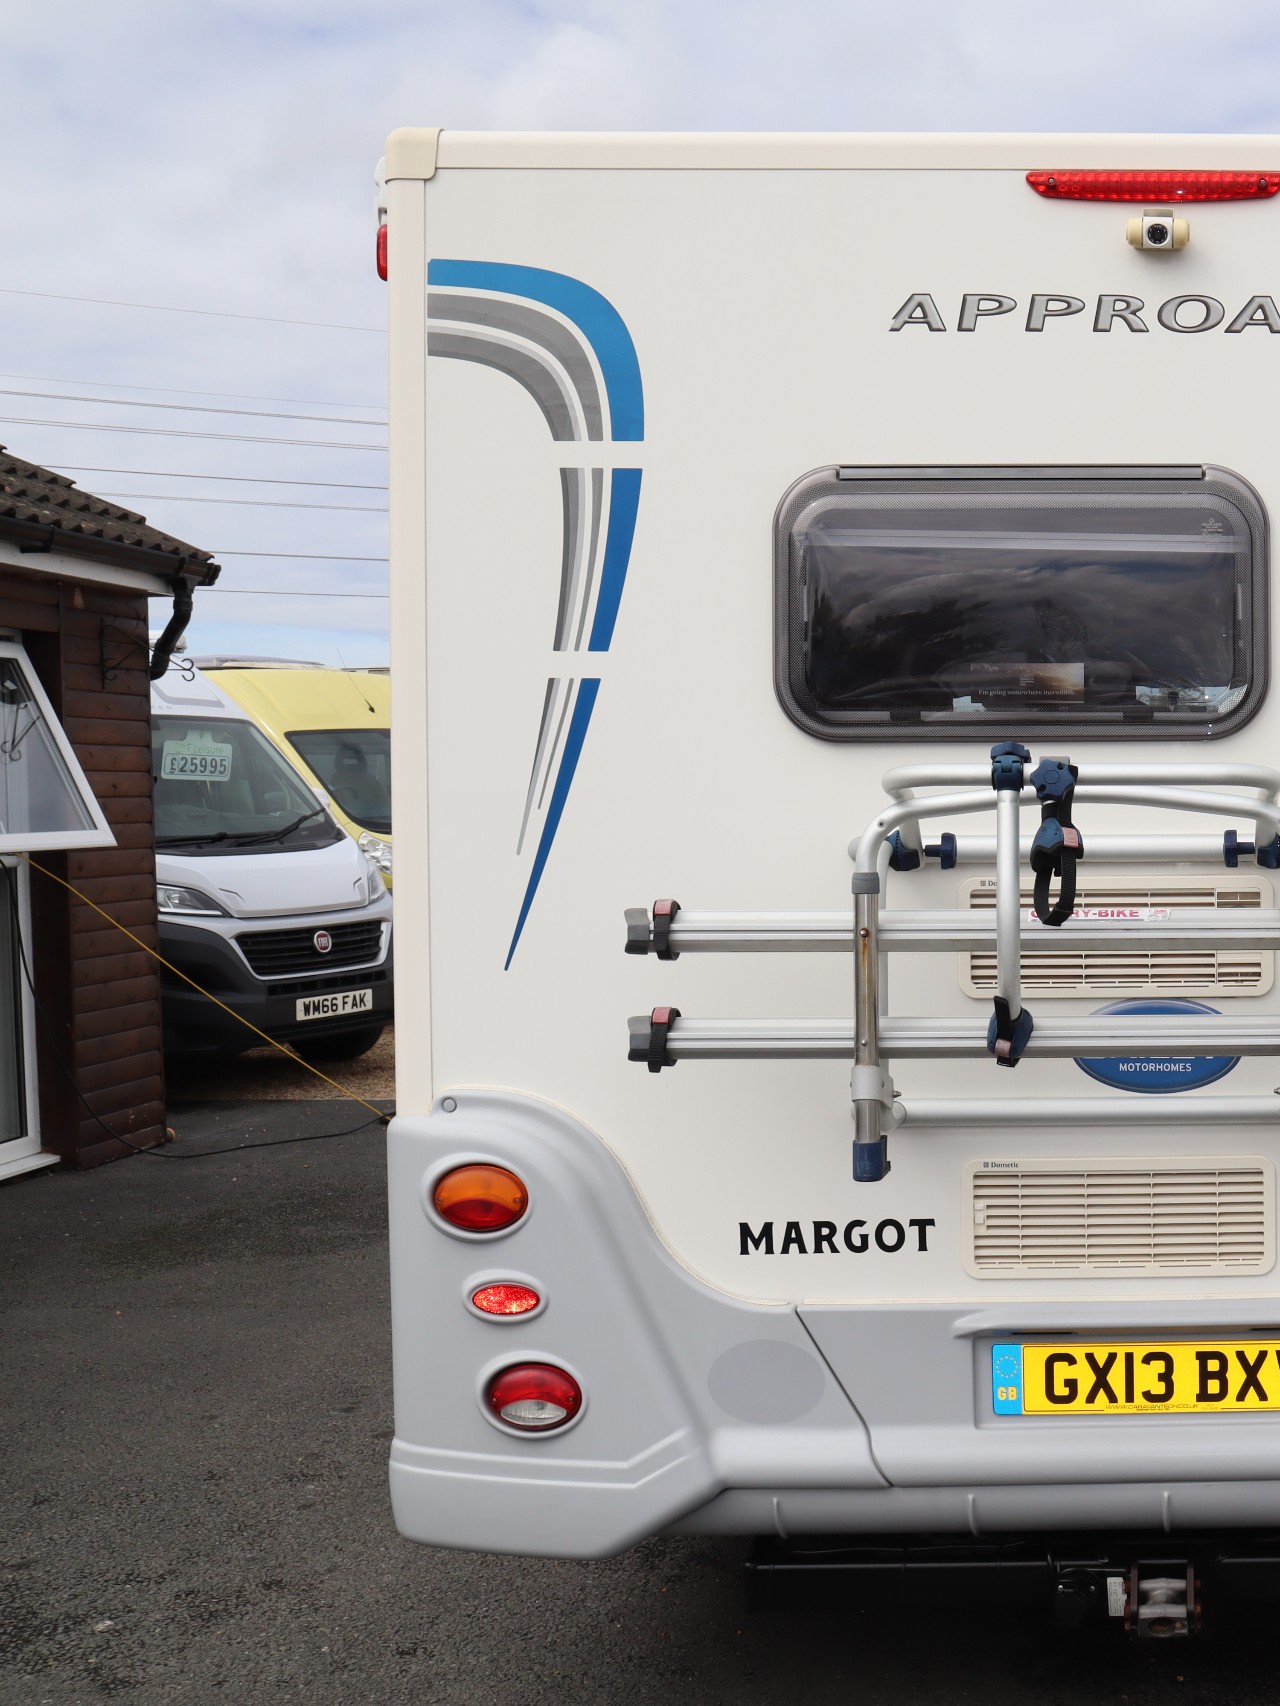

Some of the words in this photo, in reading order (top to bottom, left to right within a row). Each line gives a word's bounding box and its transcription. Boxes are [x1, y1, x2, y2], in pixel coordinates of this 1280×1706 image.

[989, 688, 1007, 697] going
[1007, 688, 1043, 696] somewhere
[193, 743, 225, 755] Leisure
[169, 756, 228, 775] £25995
[303, 996, 339, 1017] WM66
[342, 992, 367, 1011] FAK
[1119, 1062, 1192, 1072] MOTORHOMES
[738, 1218, 936, 1255] MARGOT
[1044, 1351, 1175, 1405] GX13
[997, 1386, 1018, 1401] GB
